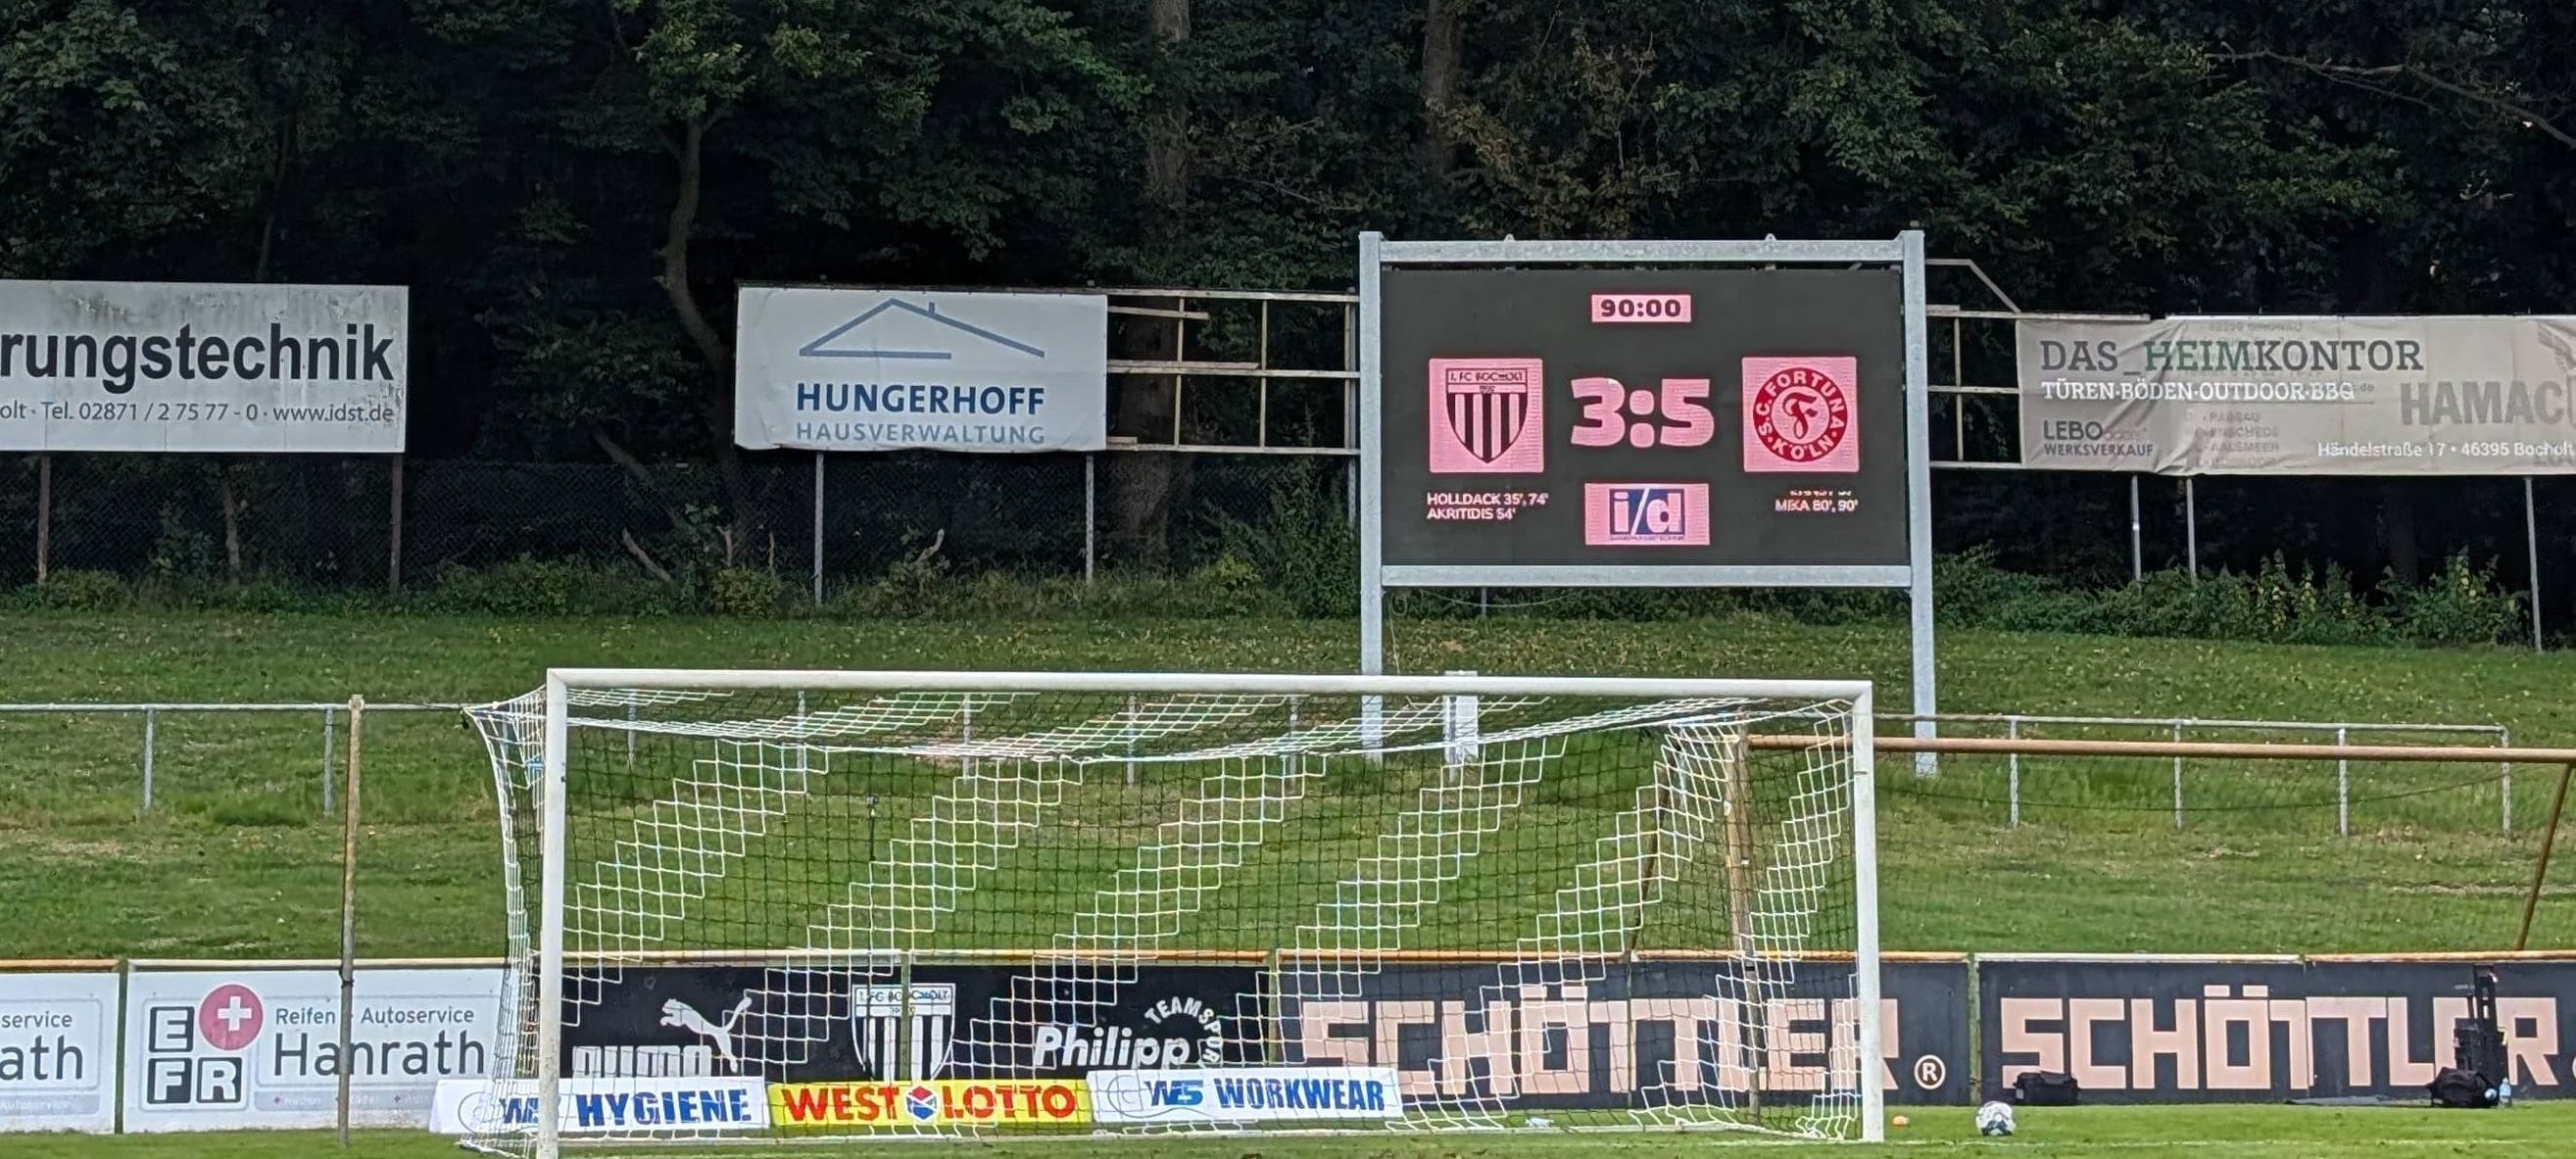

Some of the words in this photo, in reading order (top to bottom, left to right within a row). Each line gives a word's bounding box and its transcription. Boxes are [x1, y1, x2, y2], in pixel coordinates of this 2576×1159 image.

[1600, 299, 1681, 317] 90:00
[0, 323, 394, 394] rungstechnik
[40, 402, 73, 419] Tel.
[78, 403, 137, 420] 02871
[158, 403, 170, 421] 2
[175, 403, 199, 421] 75
[205, 403, 229, 421] 77
[246, 403, 259, 421] 0
[272, 403, 395, 422] www.idst.de
[797, 383, 1045, 414] HUNGERHOFF
[1571, 377, 1715, 448] 3:5
[1765, 370, 1845, 428] FORTUNA
[797, 421, 1045, 444] HAUSVERWALTUNG
[2043, 420, 2104, 441] LEBO
[2044, 444, 2154, 457] WERKSVERKAUF
[2318, 442, 2423, 458] Händelstraße
[2428, 442, 2446, 458] 17
[2460, 442, 2509, 458] 46395
[2514, 441, 2574, 458] Bocholt
[1427, 493, 1501, 506] HOLLDACK
[275, 1007, 336, 1026] Reifen
[361, 1006, 474, 1026] Autoservice
[274, 1030, 485, 1077] Hanrath
[1033, 1025, 1191, 1070] Philipp
[1302, 986, 1899, 1093] SCHÖTTLER
[0, 1036, 83, 1080] ath
[576, 1088, 753, 1127] HYGIENE
[784, 1087, 899, 1121] WEST
[944, 1084, 1076, 1119] LOTTO
[1213, 1077, 1385, 1112] WORKWEAR
